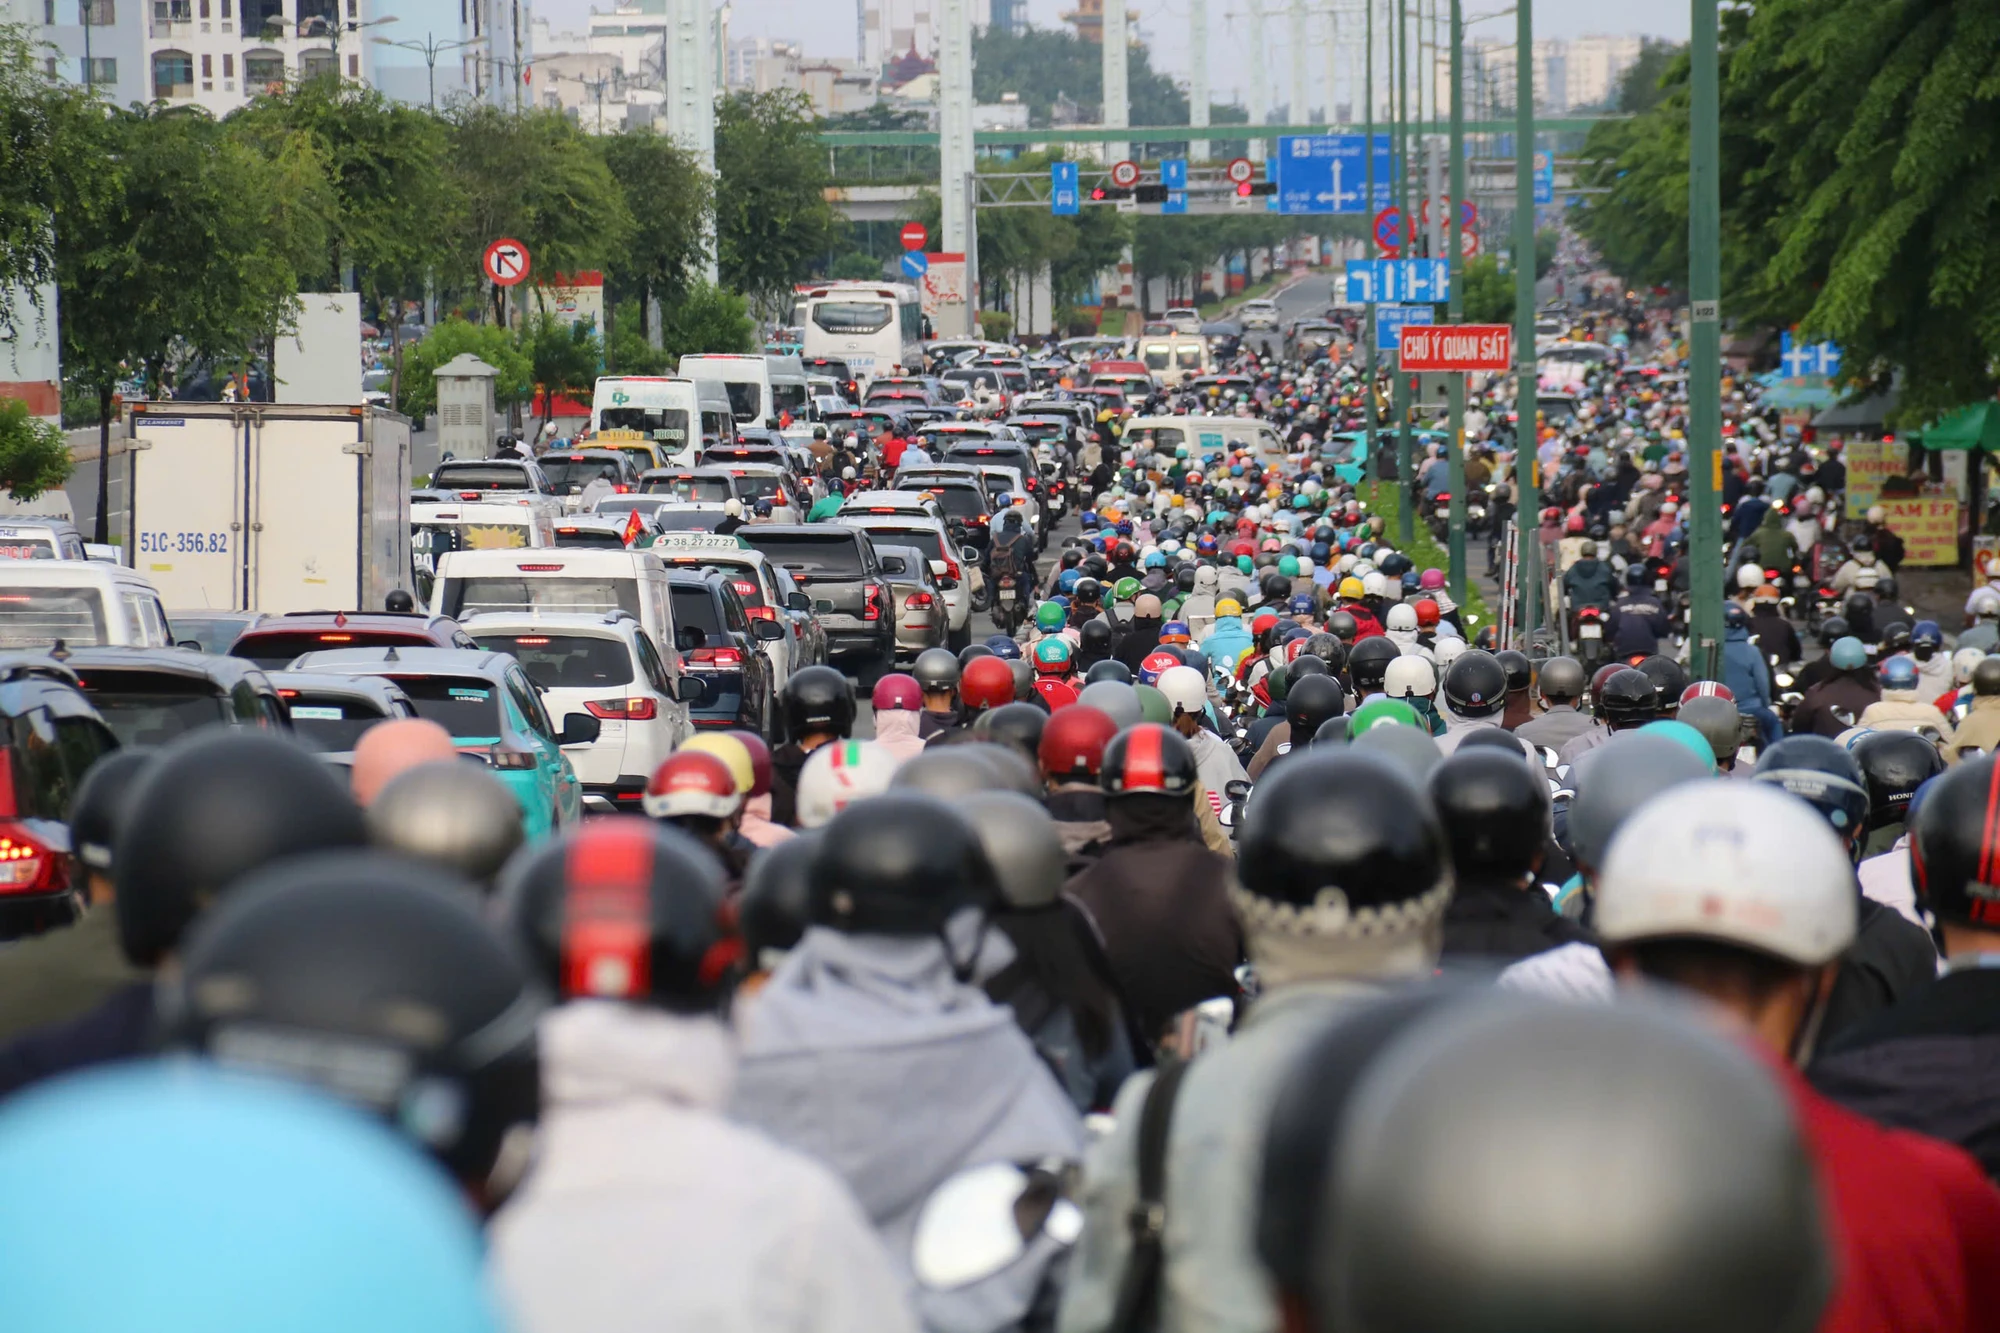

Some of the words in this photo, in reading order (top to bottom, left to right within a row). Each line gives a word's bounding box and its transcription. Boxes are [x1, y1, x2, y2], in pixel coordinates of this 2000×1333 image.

[1404, 330, 1429, 360] CHÚ
[1432, 330, 1441, 360] Ý
[1443, 335, 1478, 361] QUAN
[1480, 330, 1507, 360] SÁT
[140, 532, 227, 553] 51C-356.82
[1888, 792, 1914, 801] HON
